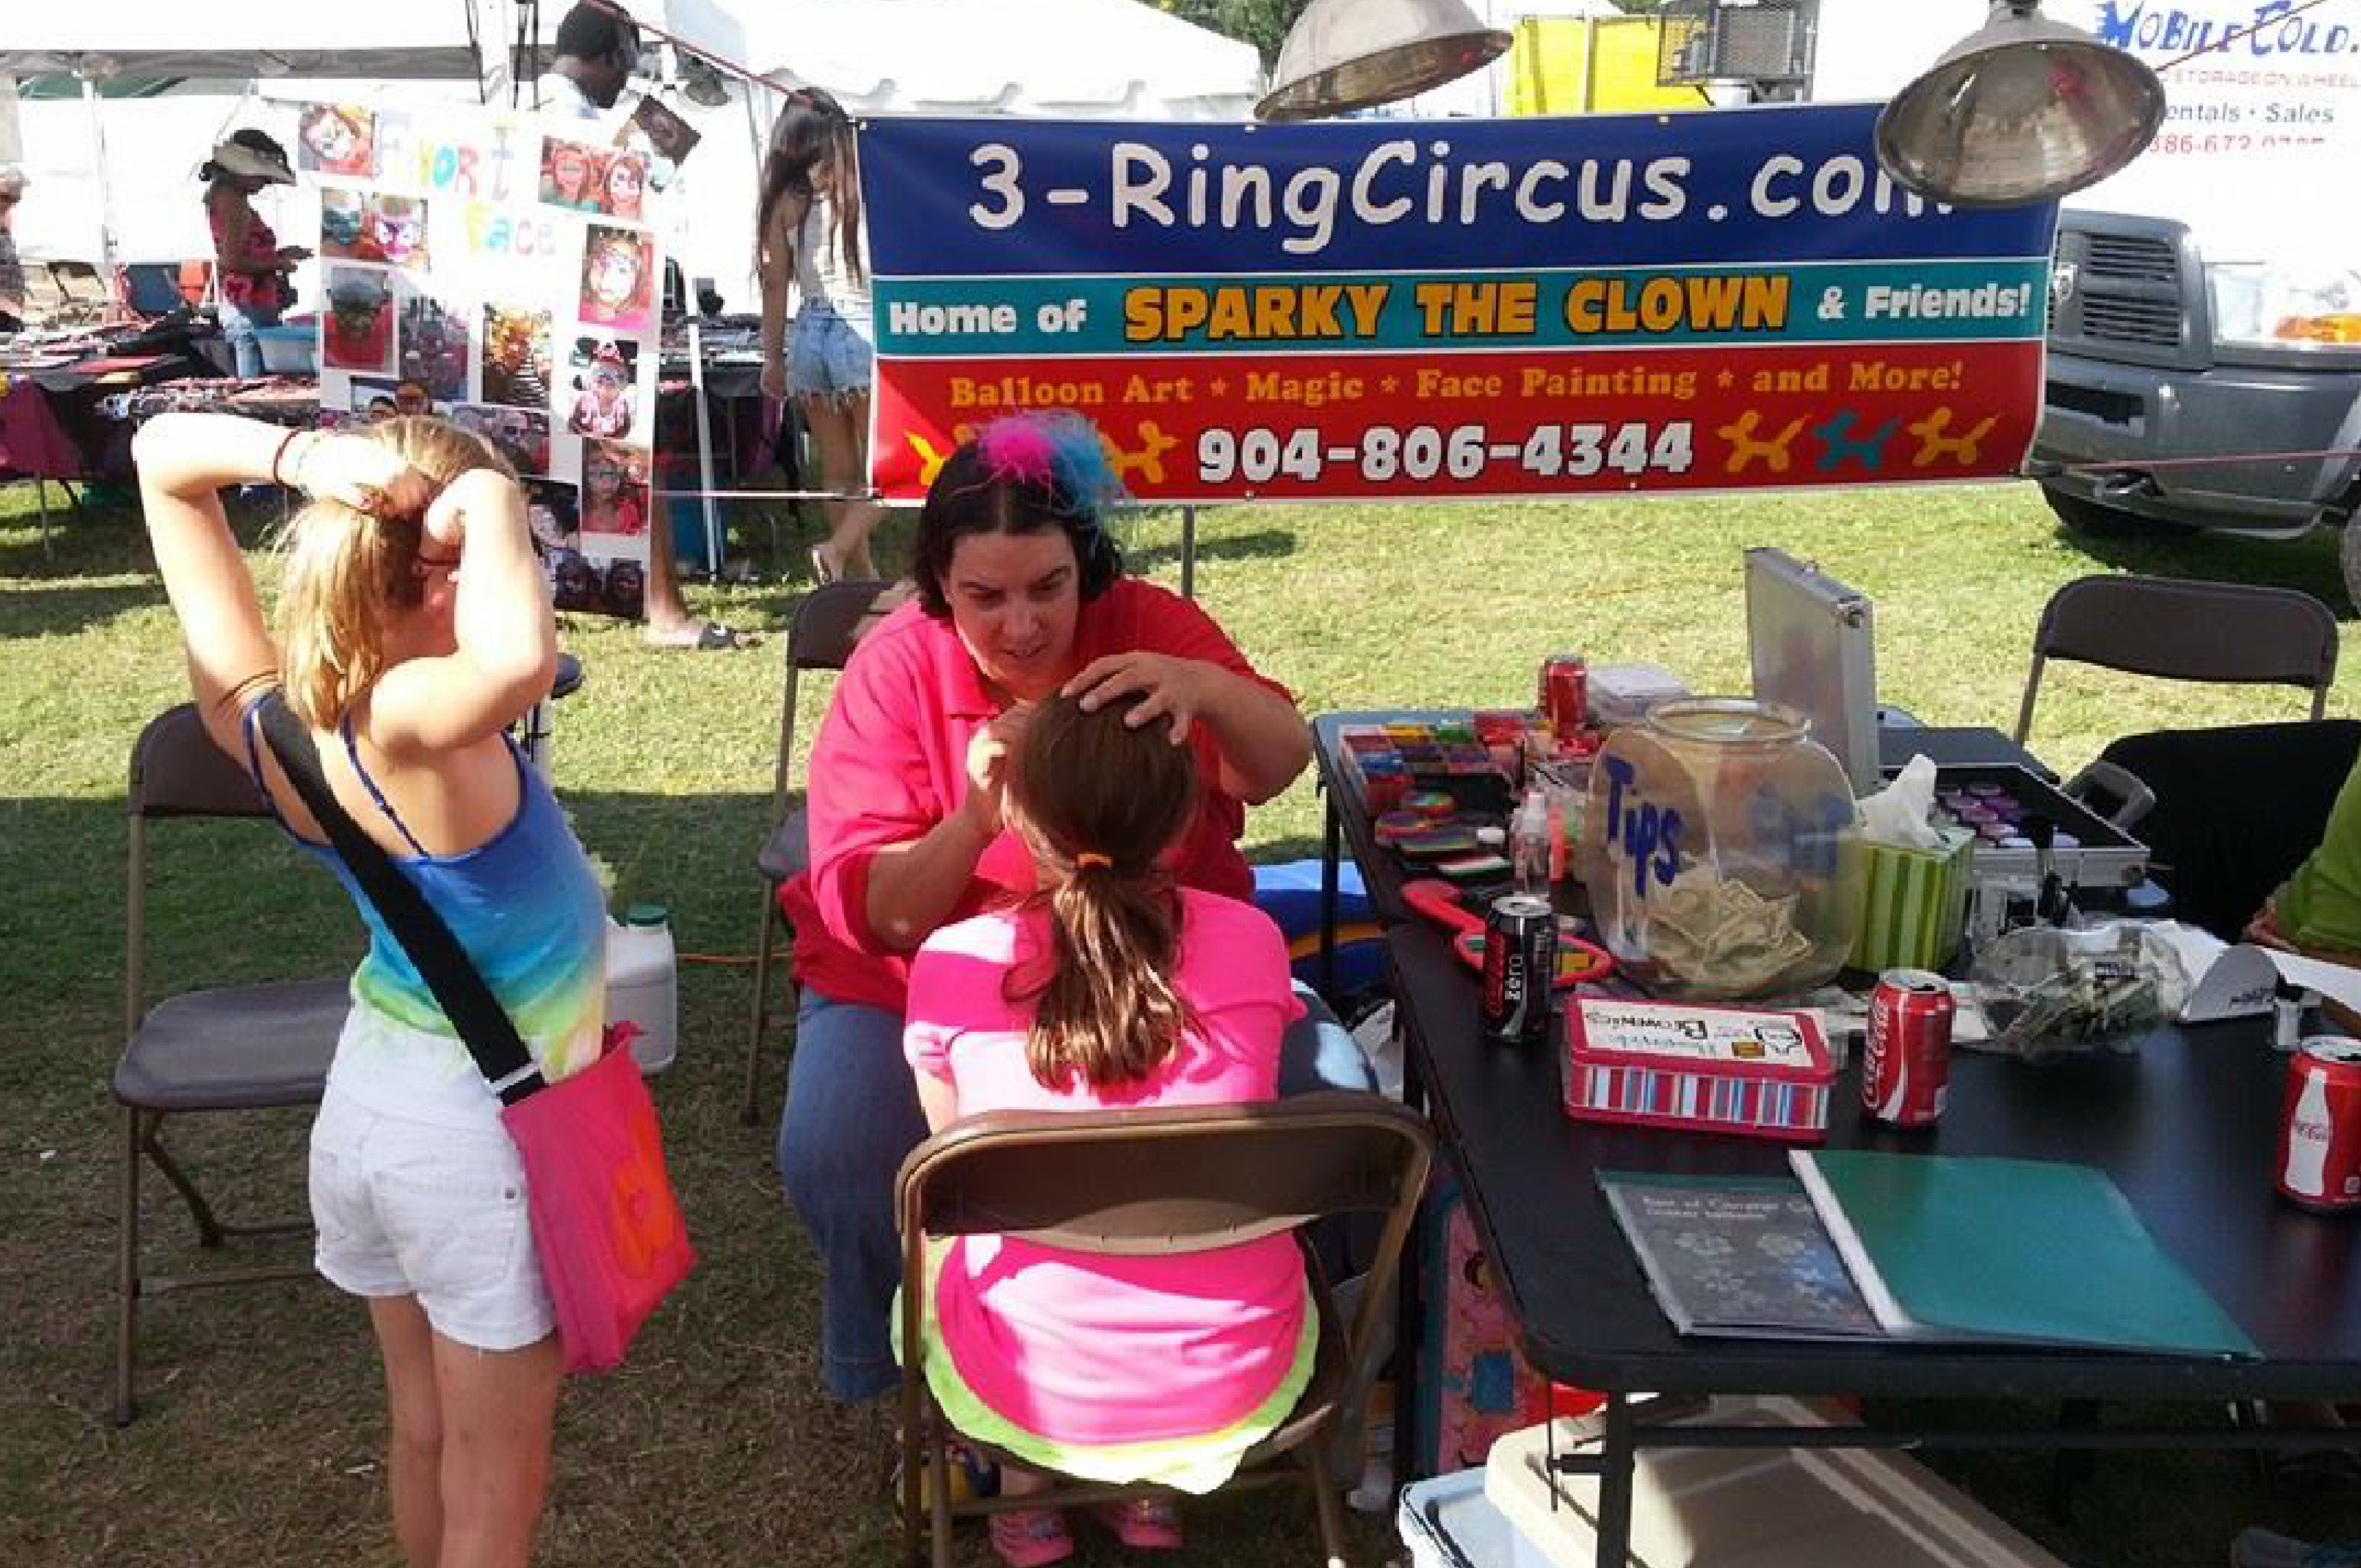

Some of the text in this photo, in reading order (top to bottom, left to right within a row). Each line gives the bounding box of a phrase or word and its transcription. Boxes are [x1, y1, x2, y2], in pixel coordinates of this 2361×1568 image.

[2166, 102, 2334, 123] entals Sales
[889, 273, 2032, 342] Home of SPARKY THE CLOWN & Friends!
[950, 360, 1965, 407] Balloon Art Magic Face Painting and More!
[1197, 420, 1696, 485] 904-806-4344
[1605, 753, 1683, 898] Tips
